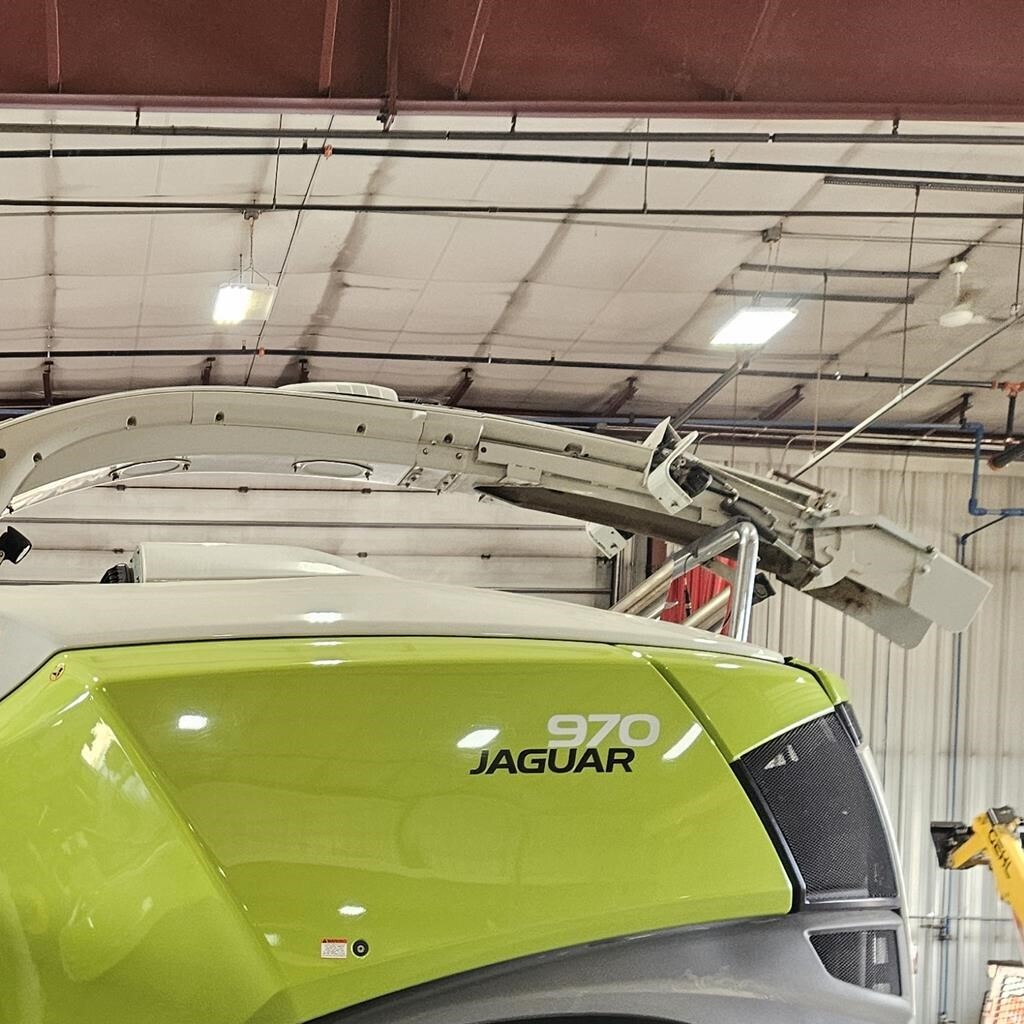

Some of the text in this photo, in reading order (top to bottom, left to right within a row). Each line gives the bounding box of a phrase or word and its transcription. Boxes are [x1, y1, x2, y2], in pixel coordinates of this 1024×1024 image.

[547, 713, 661, 749] 970
[469, 747, 636, 775] JAGUAR
[988, 829, 1012, 879] GEHL
